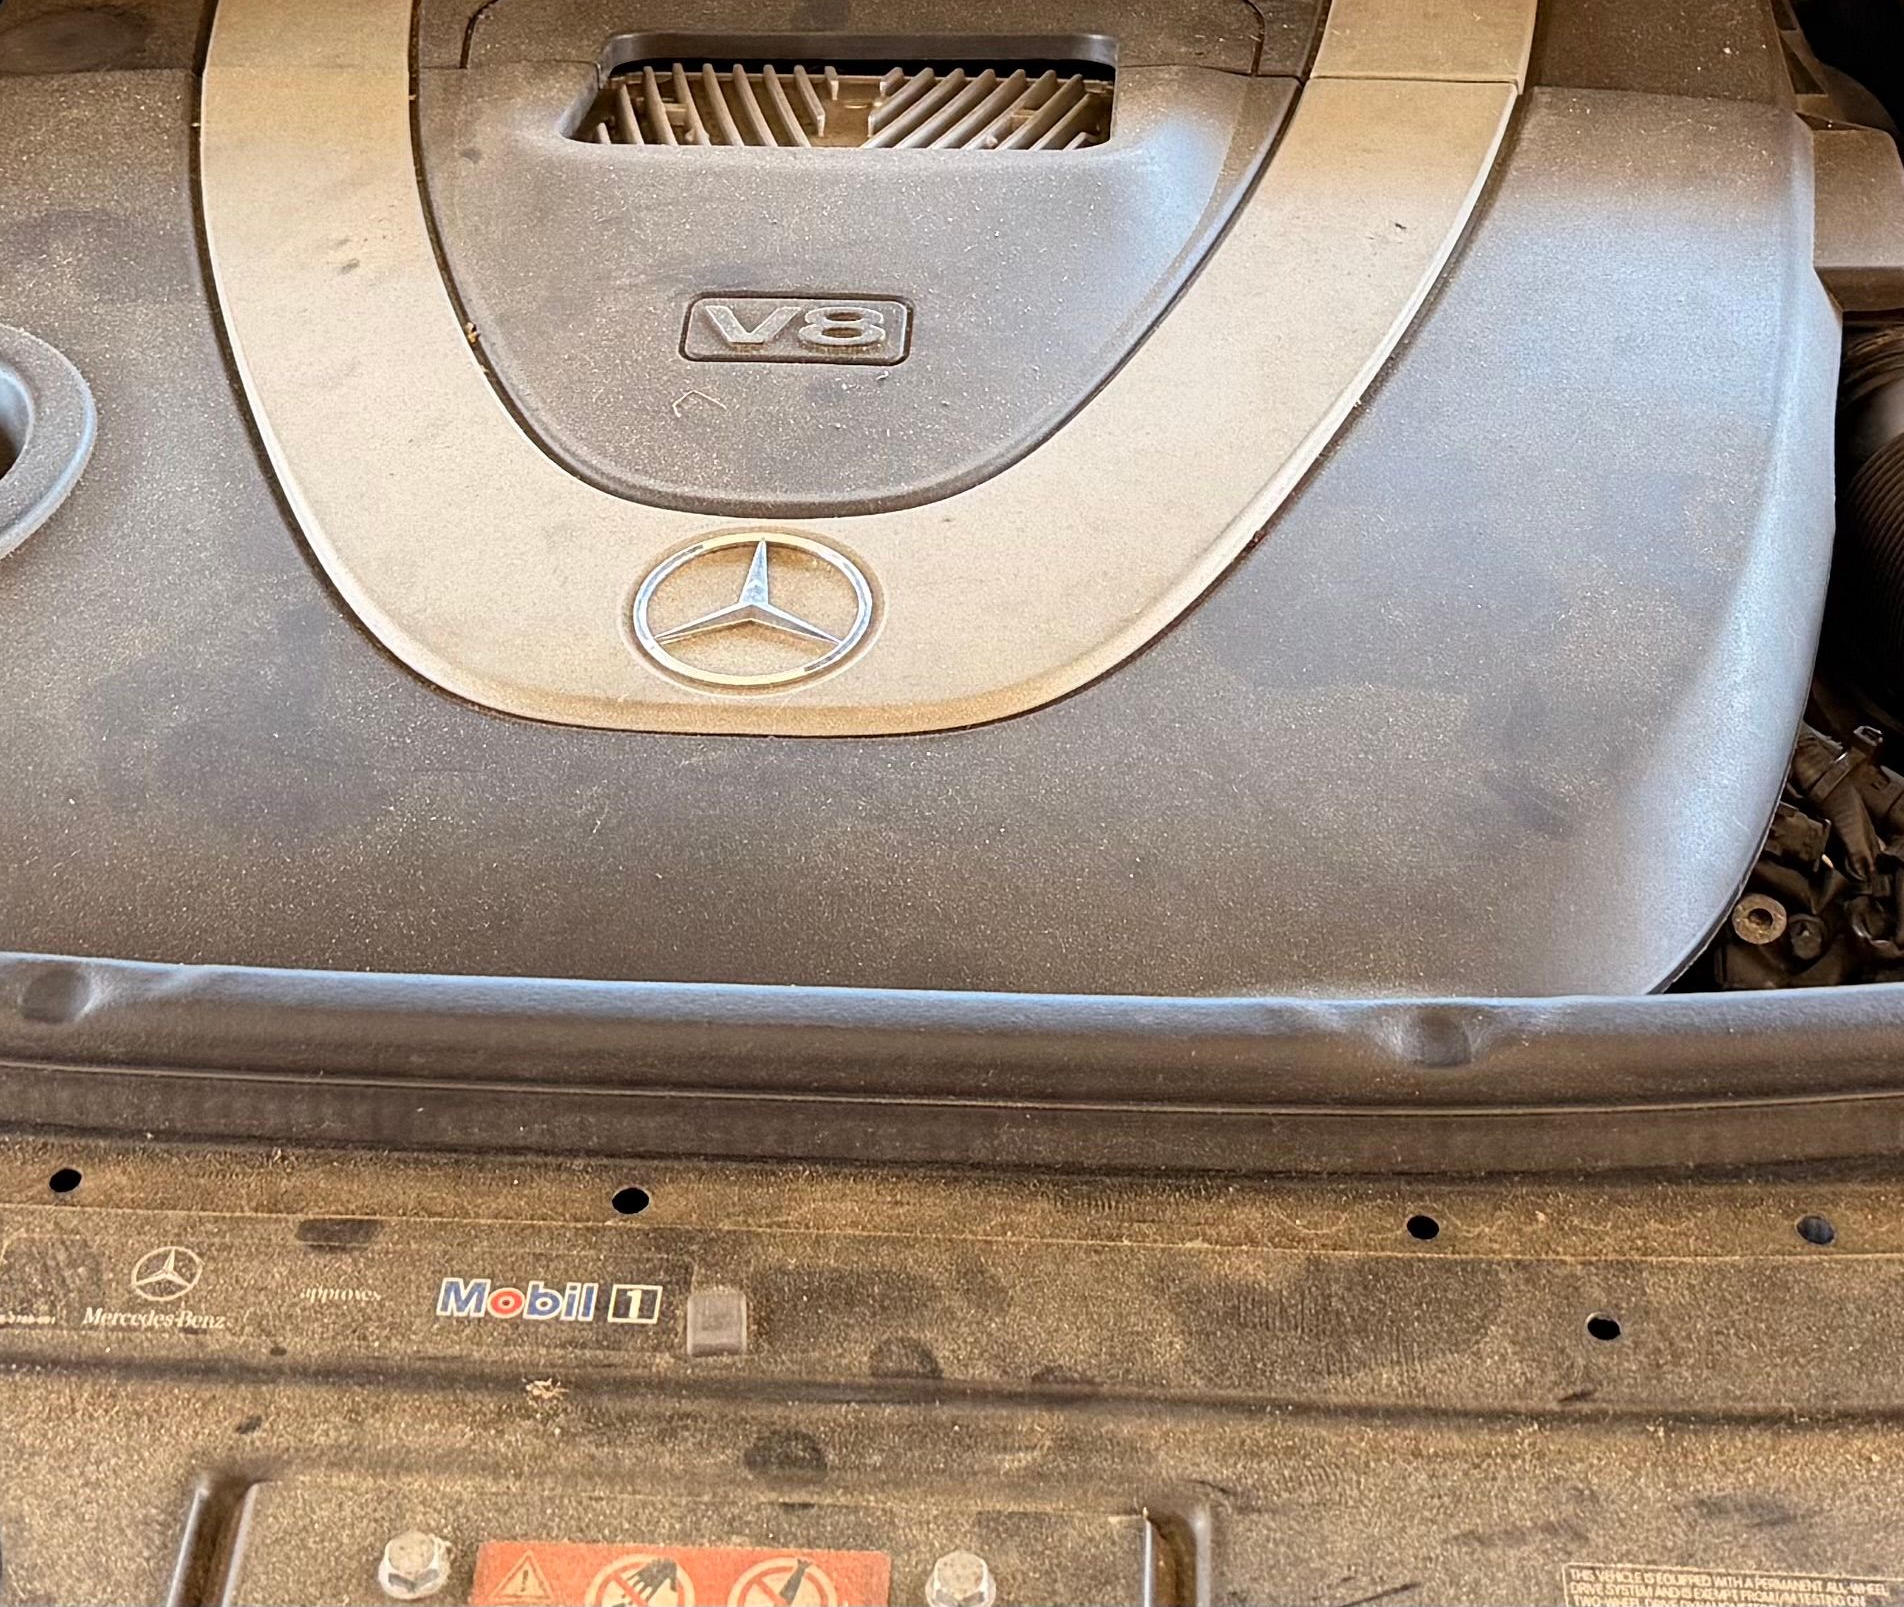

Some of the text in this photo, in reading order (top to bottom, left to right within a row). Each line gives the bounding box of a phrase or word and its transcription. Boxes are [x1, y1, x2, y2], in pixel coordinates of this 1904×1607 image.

[705, 305, 886, 349] V8
[299, 1284, 382, 1304] approves
[435, 1277, 599, 1323] Mobil
[82, 1306, 227, 1328] Mercedes-Benz
[1569, 1569, 1595, 1582] THIS
[1597, 1570, 1642, 1584] VEHICLE
[1656, 1573, 1712, 1587] EQUIPPED
[1712, 1575, 1742, 1588] WITH
[1743, 1576, 1753, 1589] A
[1755, 1577, 1823, 1592] PERMANENT
[1827, 1581, 1889, 1596] ALL-WHEEL
[1570, 1582, 1603, 1595] DRIVE
[1605, 1584, 1653, 1597] SYSTEM
[1654, 1586, 1679, 1598] AND
[1693, 1588, 1739, 1601] EXEMPT
[1741, 1590, 1776, 1603] FROM
[1797, 1593, 1846, 1605] TESTING
